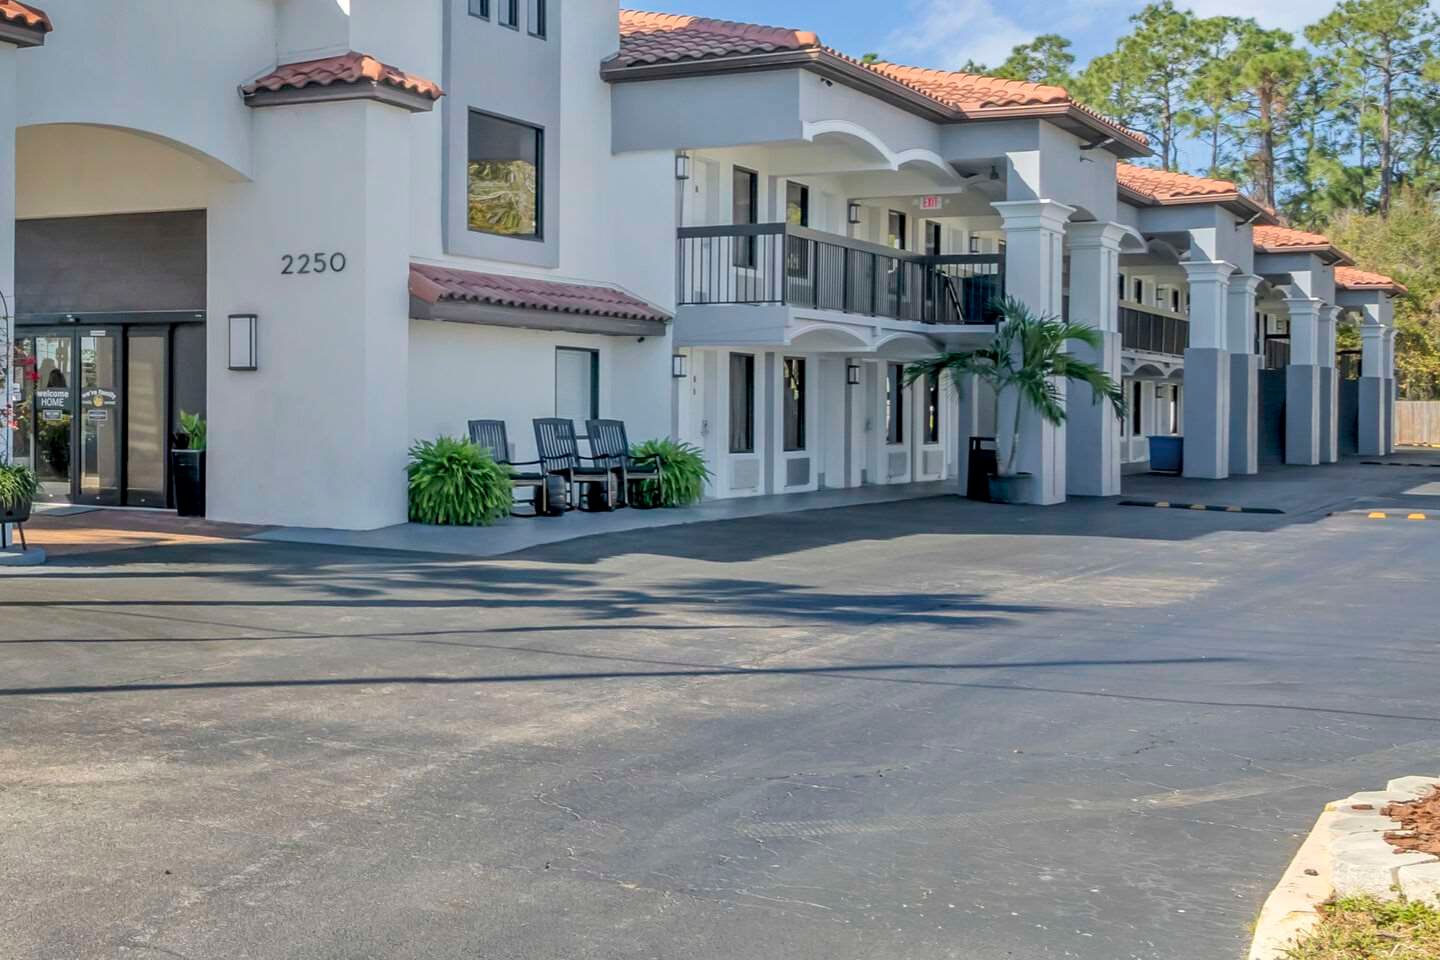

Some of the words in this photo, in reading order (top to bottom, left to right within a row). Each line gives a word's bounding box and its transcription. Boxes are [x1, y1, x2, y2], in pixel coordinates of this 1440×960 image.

[280, 252, 346, 274] 2250
[36, 390, 69, 398] welcome
[41, 398, 64, 407] HOME
